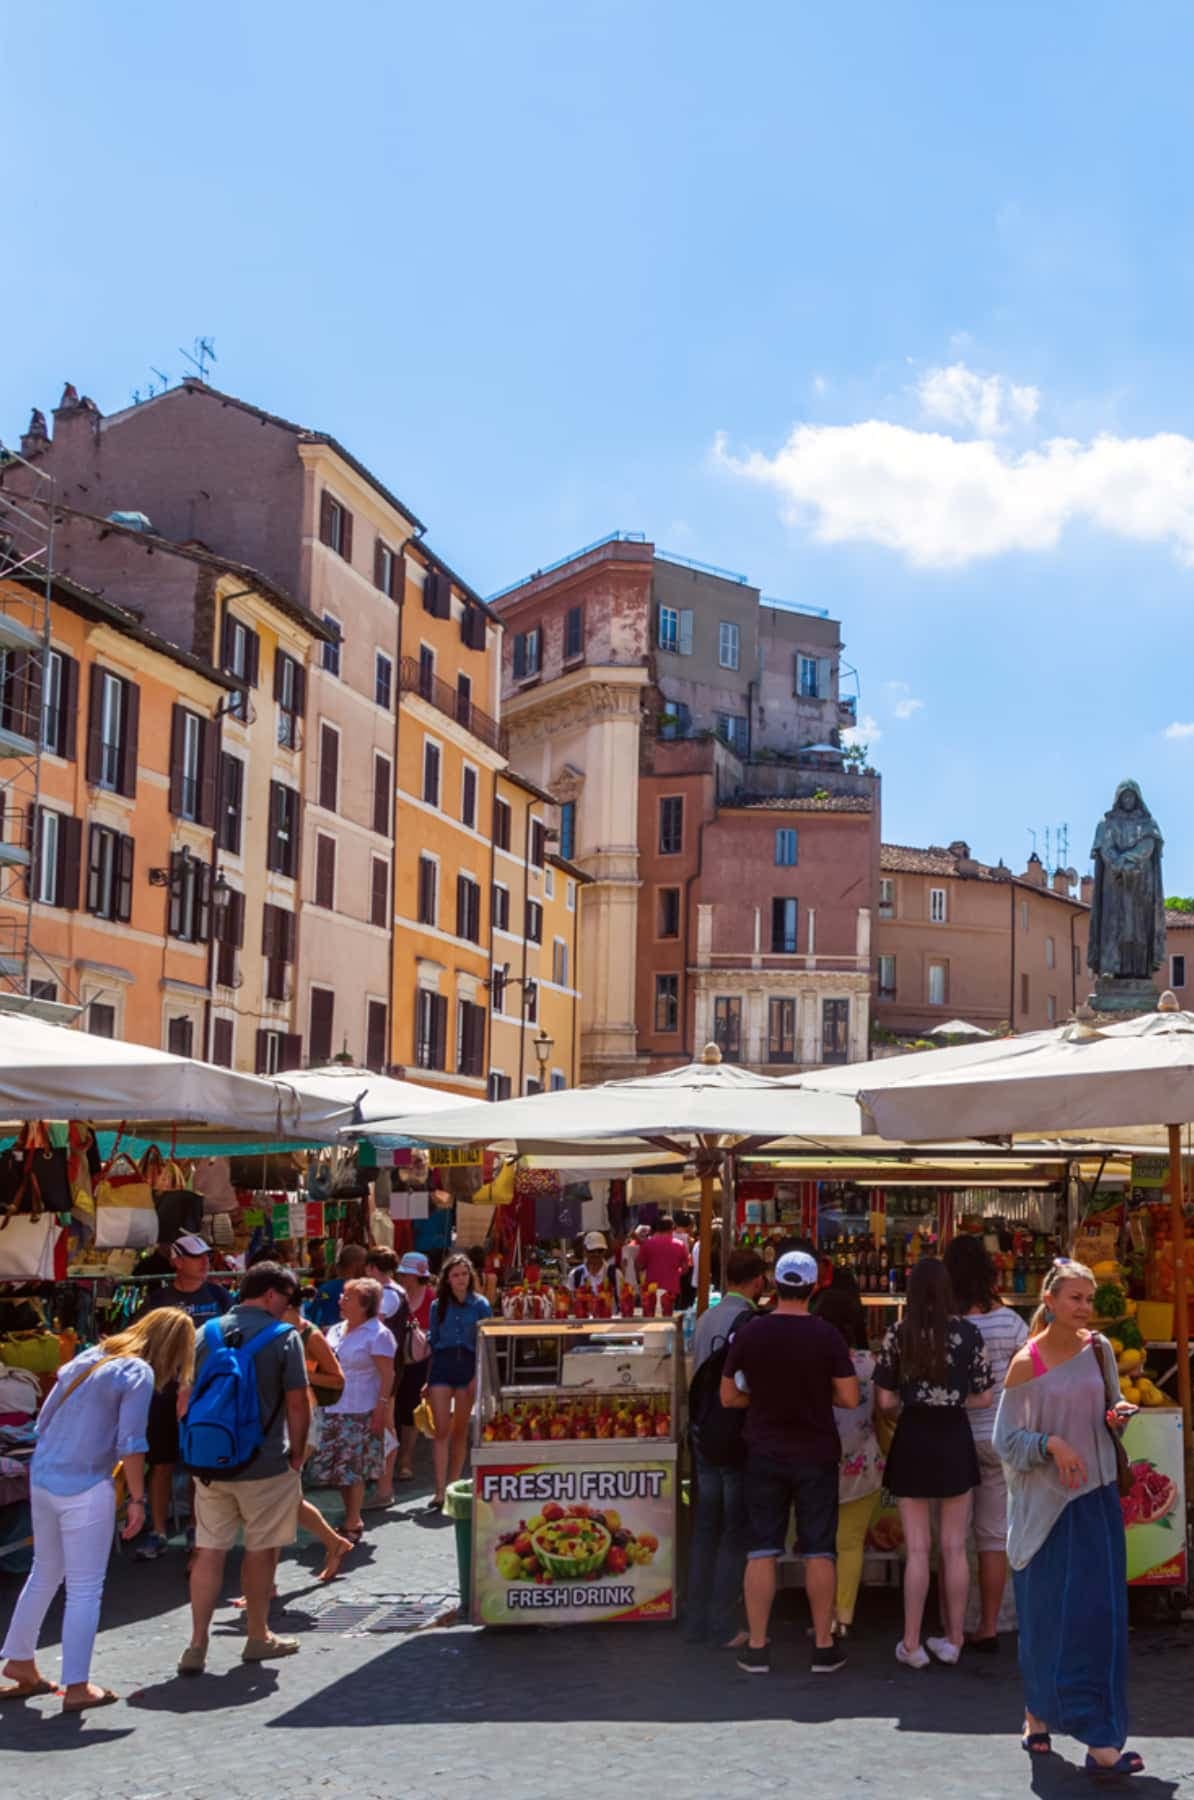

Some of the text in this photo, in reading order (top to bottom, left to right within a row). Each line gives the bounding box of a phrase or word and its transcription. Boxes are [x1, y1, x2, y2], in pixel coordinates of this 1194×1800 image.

[483, 1471, 665, 1500] FRESH FRUIT
[508, 1587, 633, 1607] FRESH DRINK
